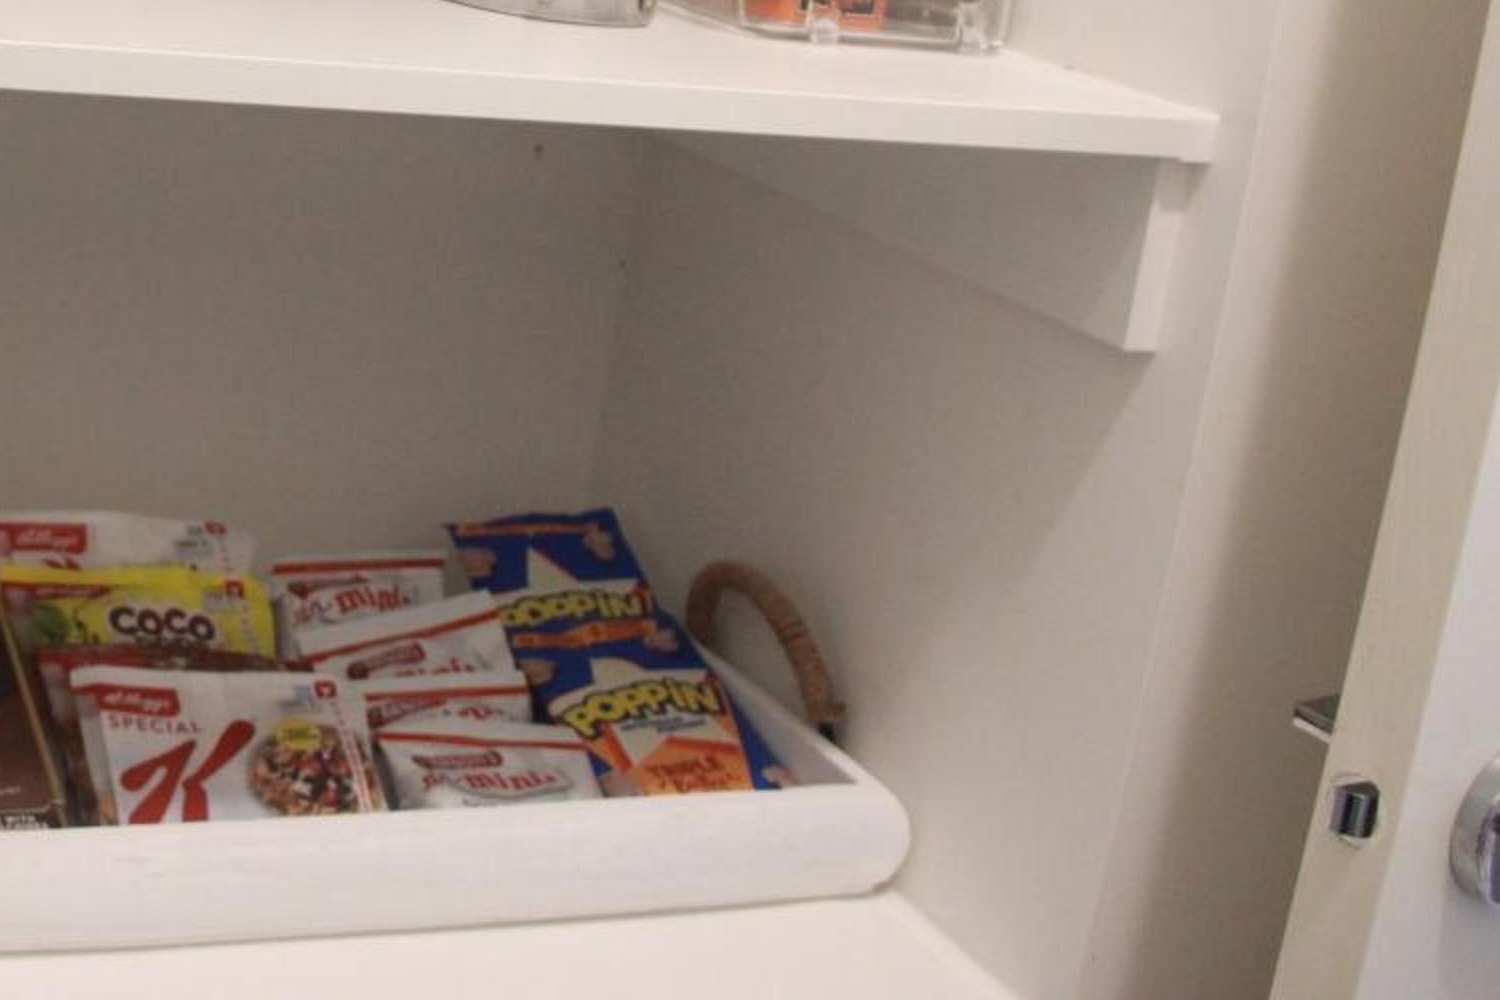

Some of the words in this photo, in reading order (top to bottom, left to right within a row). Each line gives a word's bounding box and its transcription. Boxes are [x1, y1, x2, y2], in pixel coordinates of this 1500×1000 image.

[108, 604, 216, 642] COCO
[108, 714, 200, 735] SPECIAL
[562, 677, 726, 741] POPPIN
